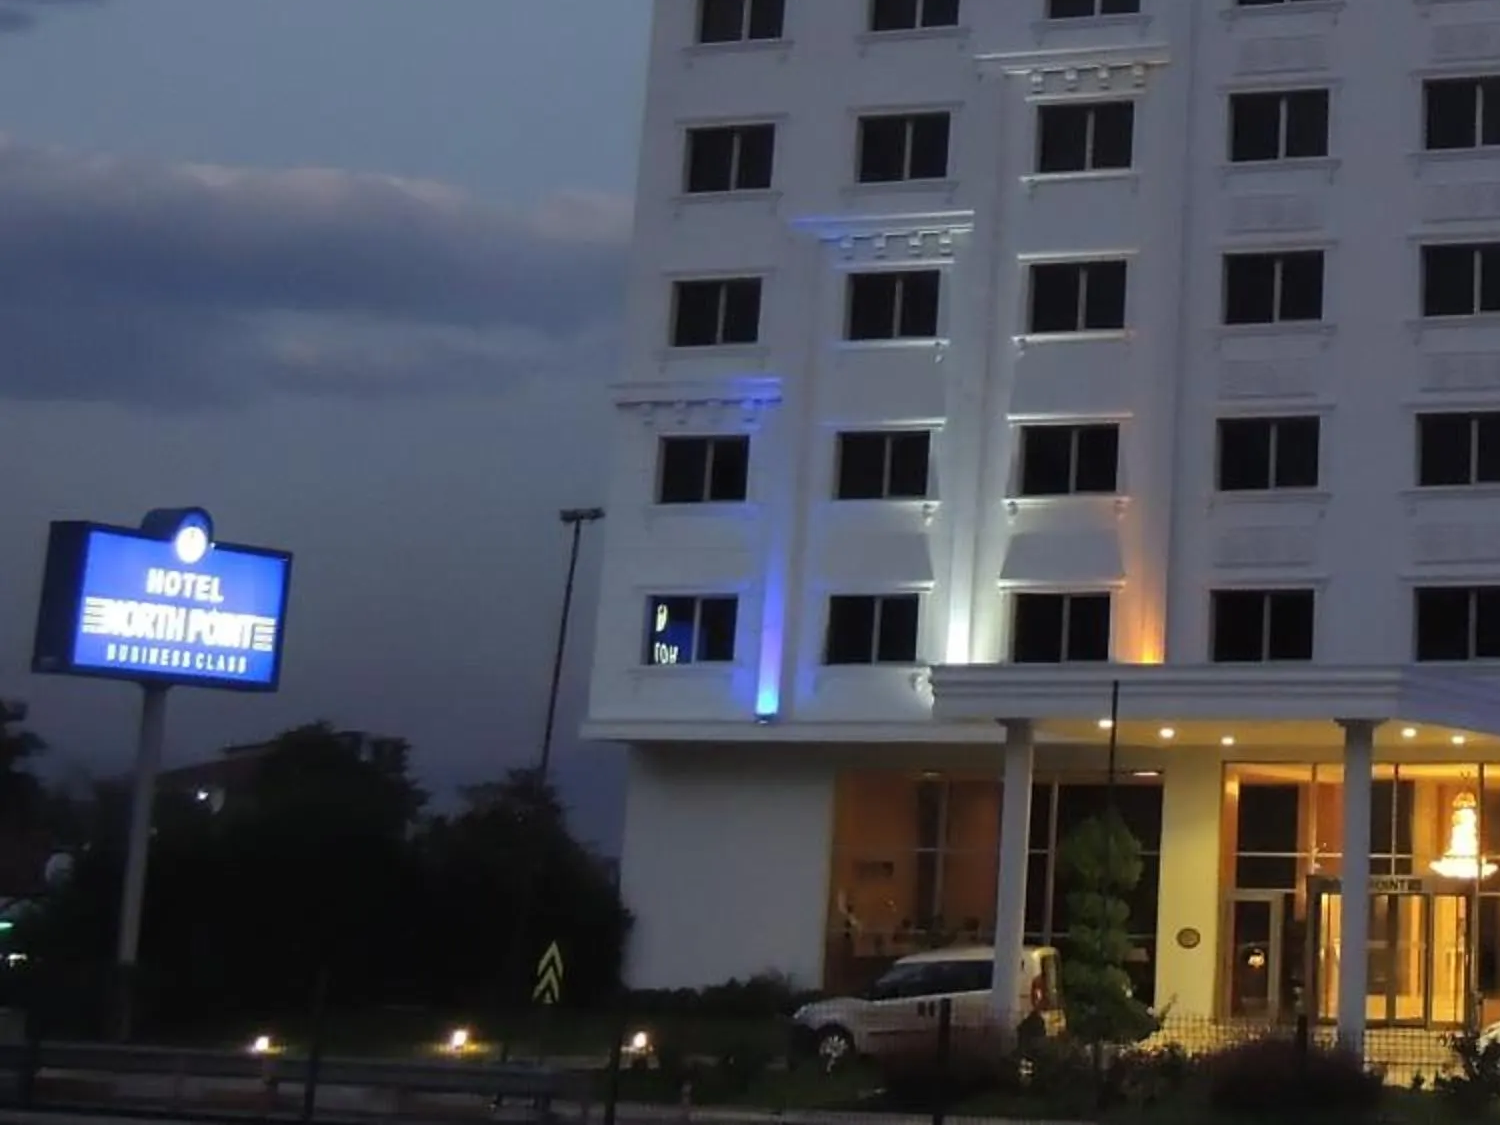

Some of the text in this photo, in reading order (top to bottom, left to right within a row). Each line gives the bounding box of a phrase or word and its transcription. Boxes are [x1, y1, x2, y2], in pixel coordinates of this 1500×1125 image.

[146, 567, 225, 603] HOTEL
[106, 599, 254, 650] NORTH POINT
[106, 642, 247, 674] BUSINESS CLASS
